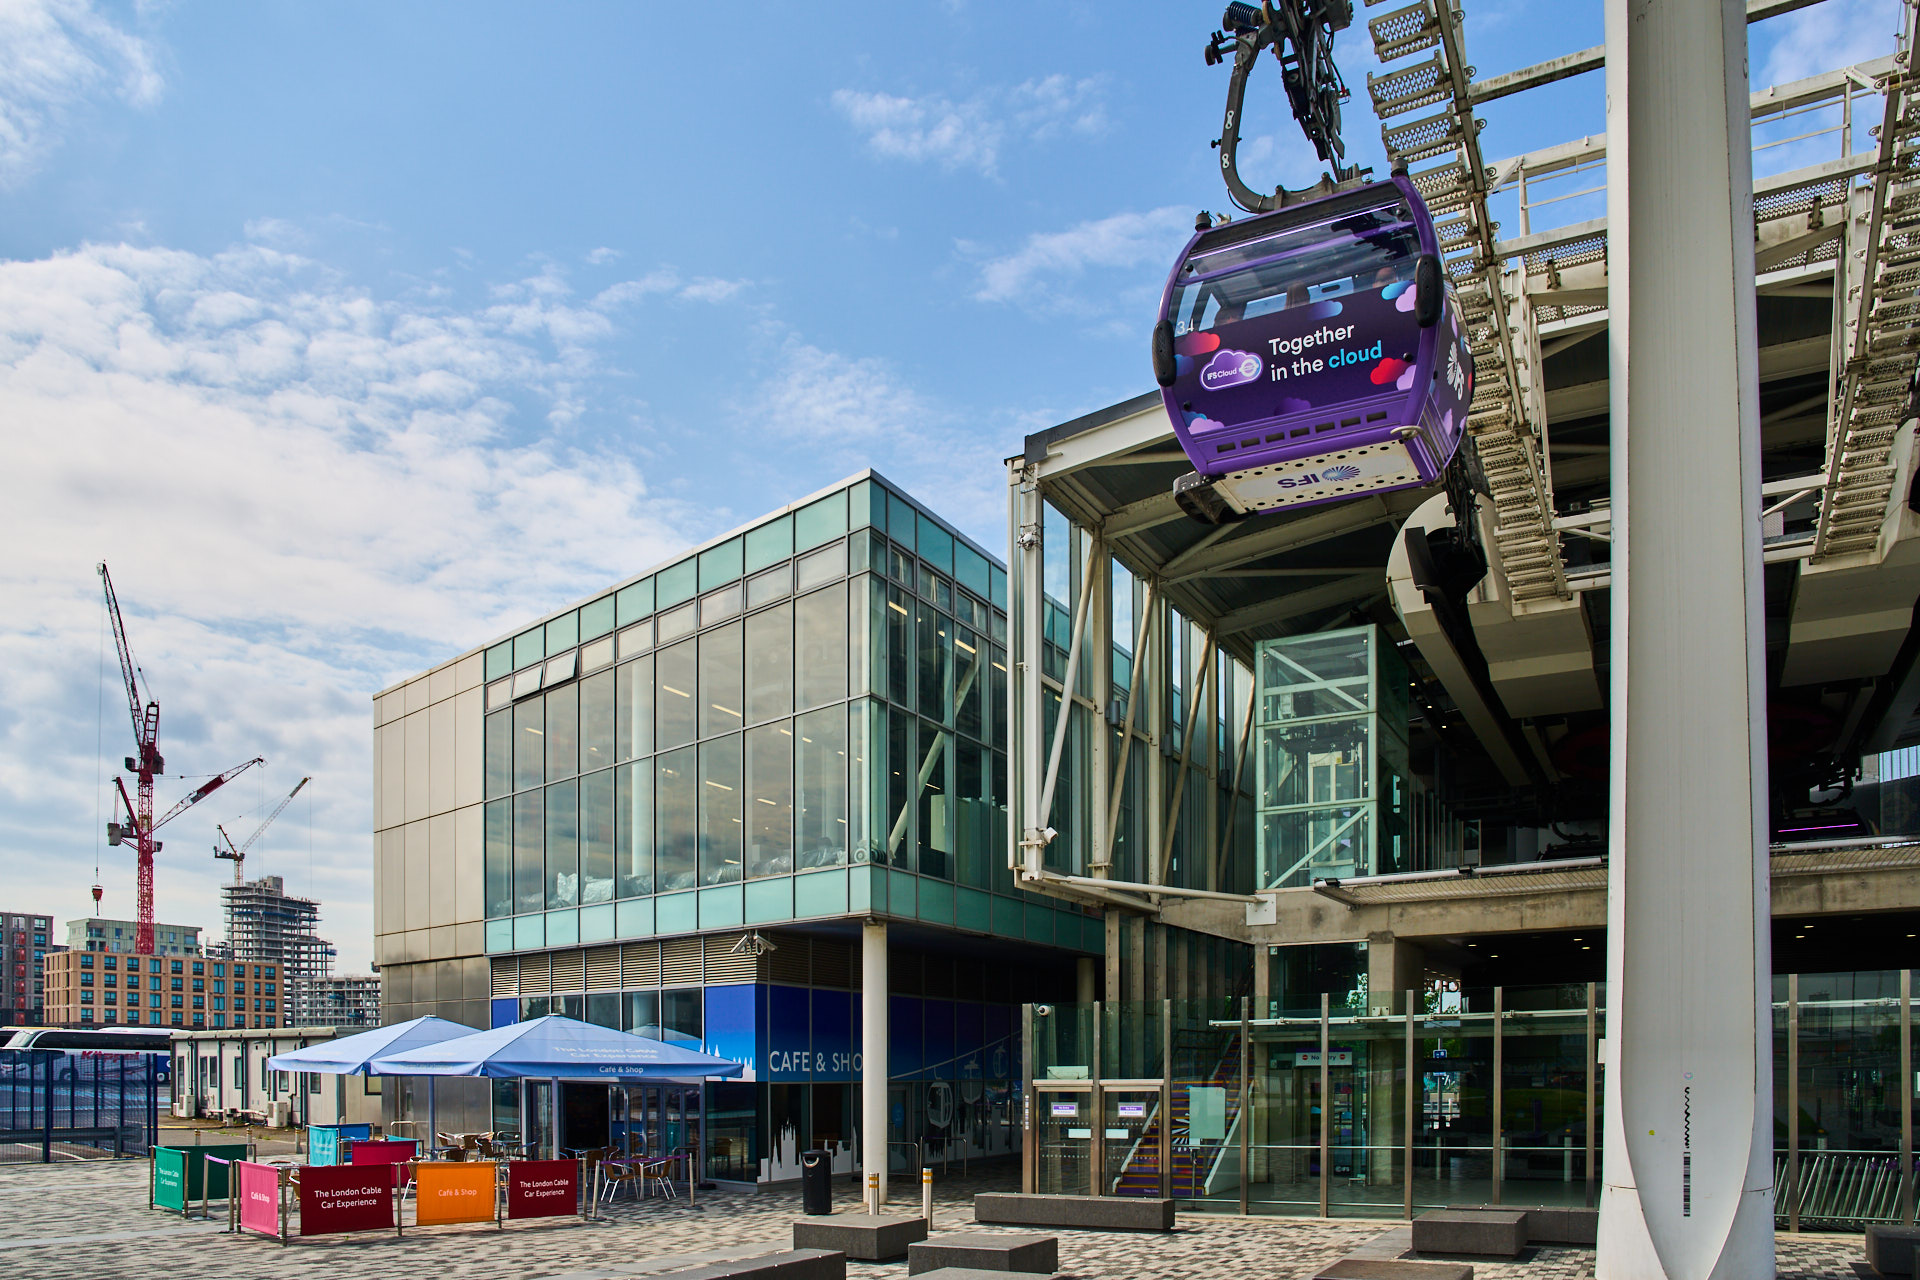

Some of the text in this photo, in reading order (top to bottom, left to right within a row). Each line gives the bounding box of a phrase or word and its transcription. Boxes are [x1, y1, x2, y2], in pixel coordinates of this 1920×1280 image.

[1269, 324, 1354, 356] Together
[1270, 340, 1383, 382] in the cloud
[1277, 473, 1320, 488] IFS
[769, 1051, 863, 1072] CAFE & SHO
[625, 1066, 643, 1074] Shop
[331, 1188, 359, 1197] London
[536, 1188, 565, 1196] Experience
[336, 1199, 377, 1208] Experience
